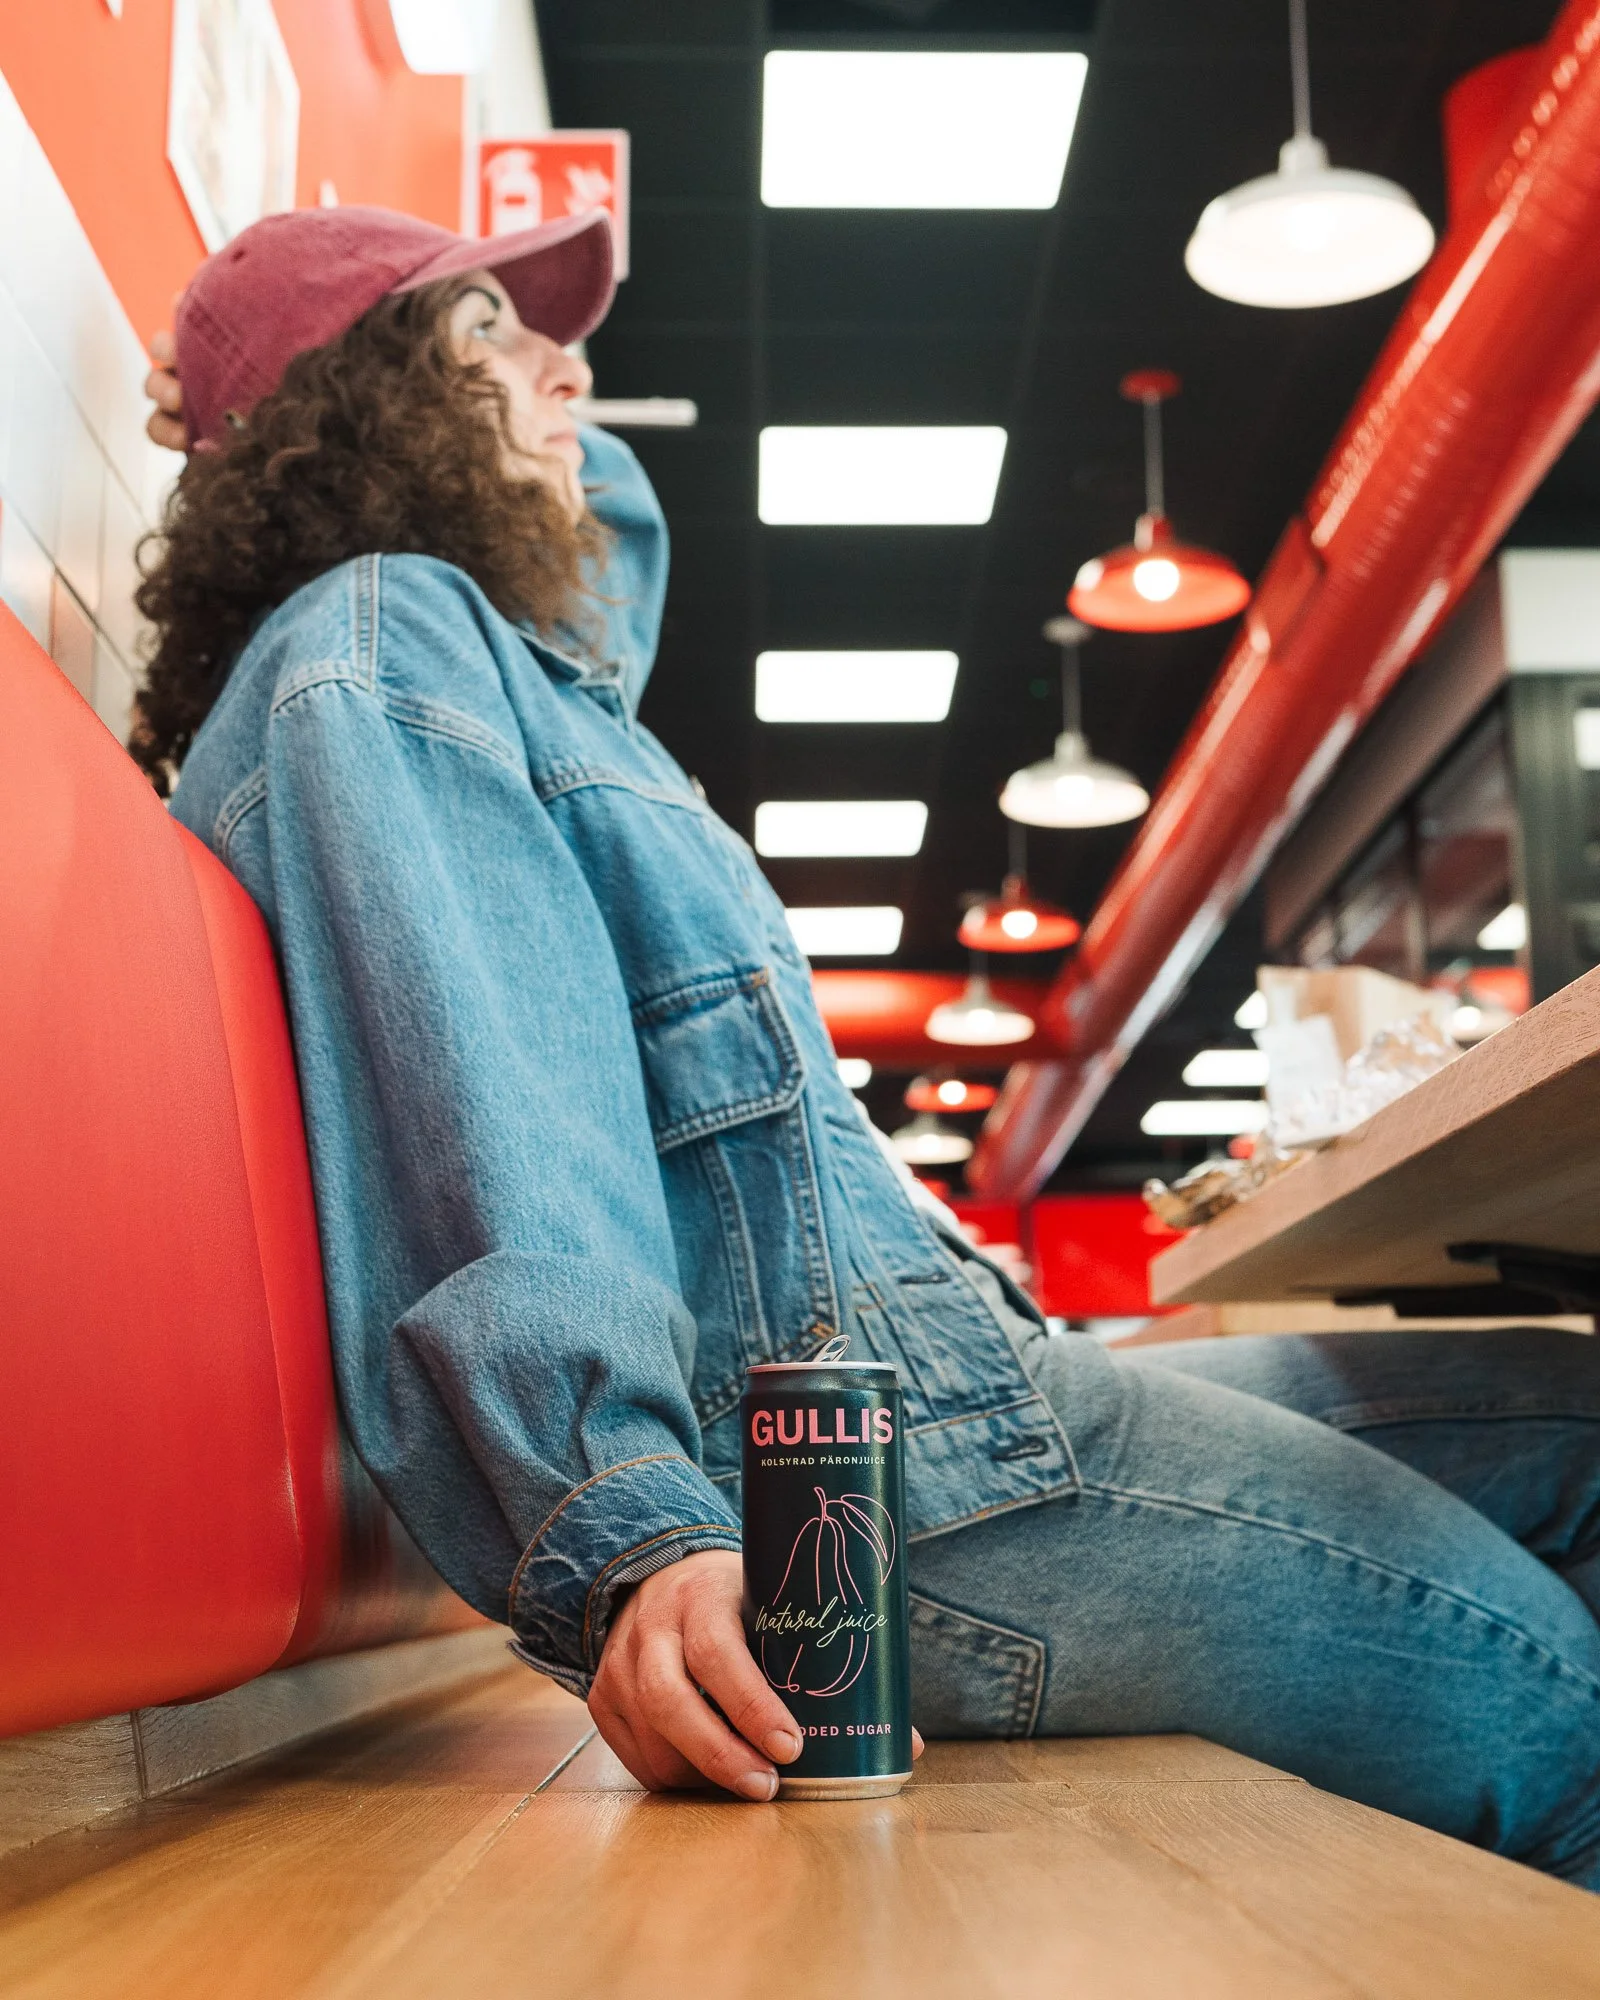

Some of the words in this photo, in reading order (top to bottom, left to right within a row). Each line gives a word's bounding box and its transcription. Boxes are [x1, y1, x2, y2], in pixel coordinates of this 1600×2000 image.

[751, 1407, 894, 1447] GULLIS
[761, 1457, 815, 1467] KOLSYRAD
[820, 1455, 886, 1465] PÄRONJUICE
[755, 1595, 839, 1635] natural
[816, 1608, 888, 1648] juice
[799, 1726, 839, 1737] DDED
[846, 1723, 892, 1736] SUGAR
